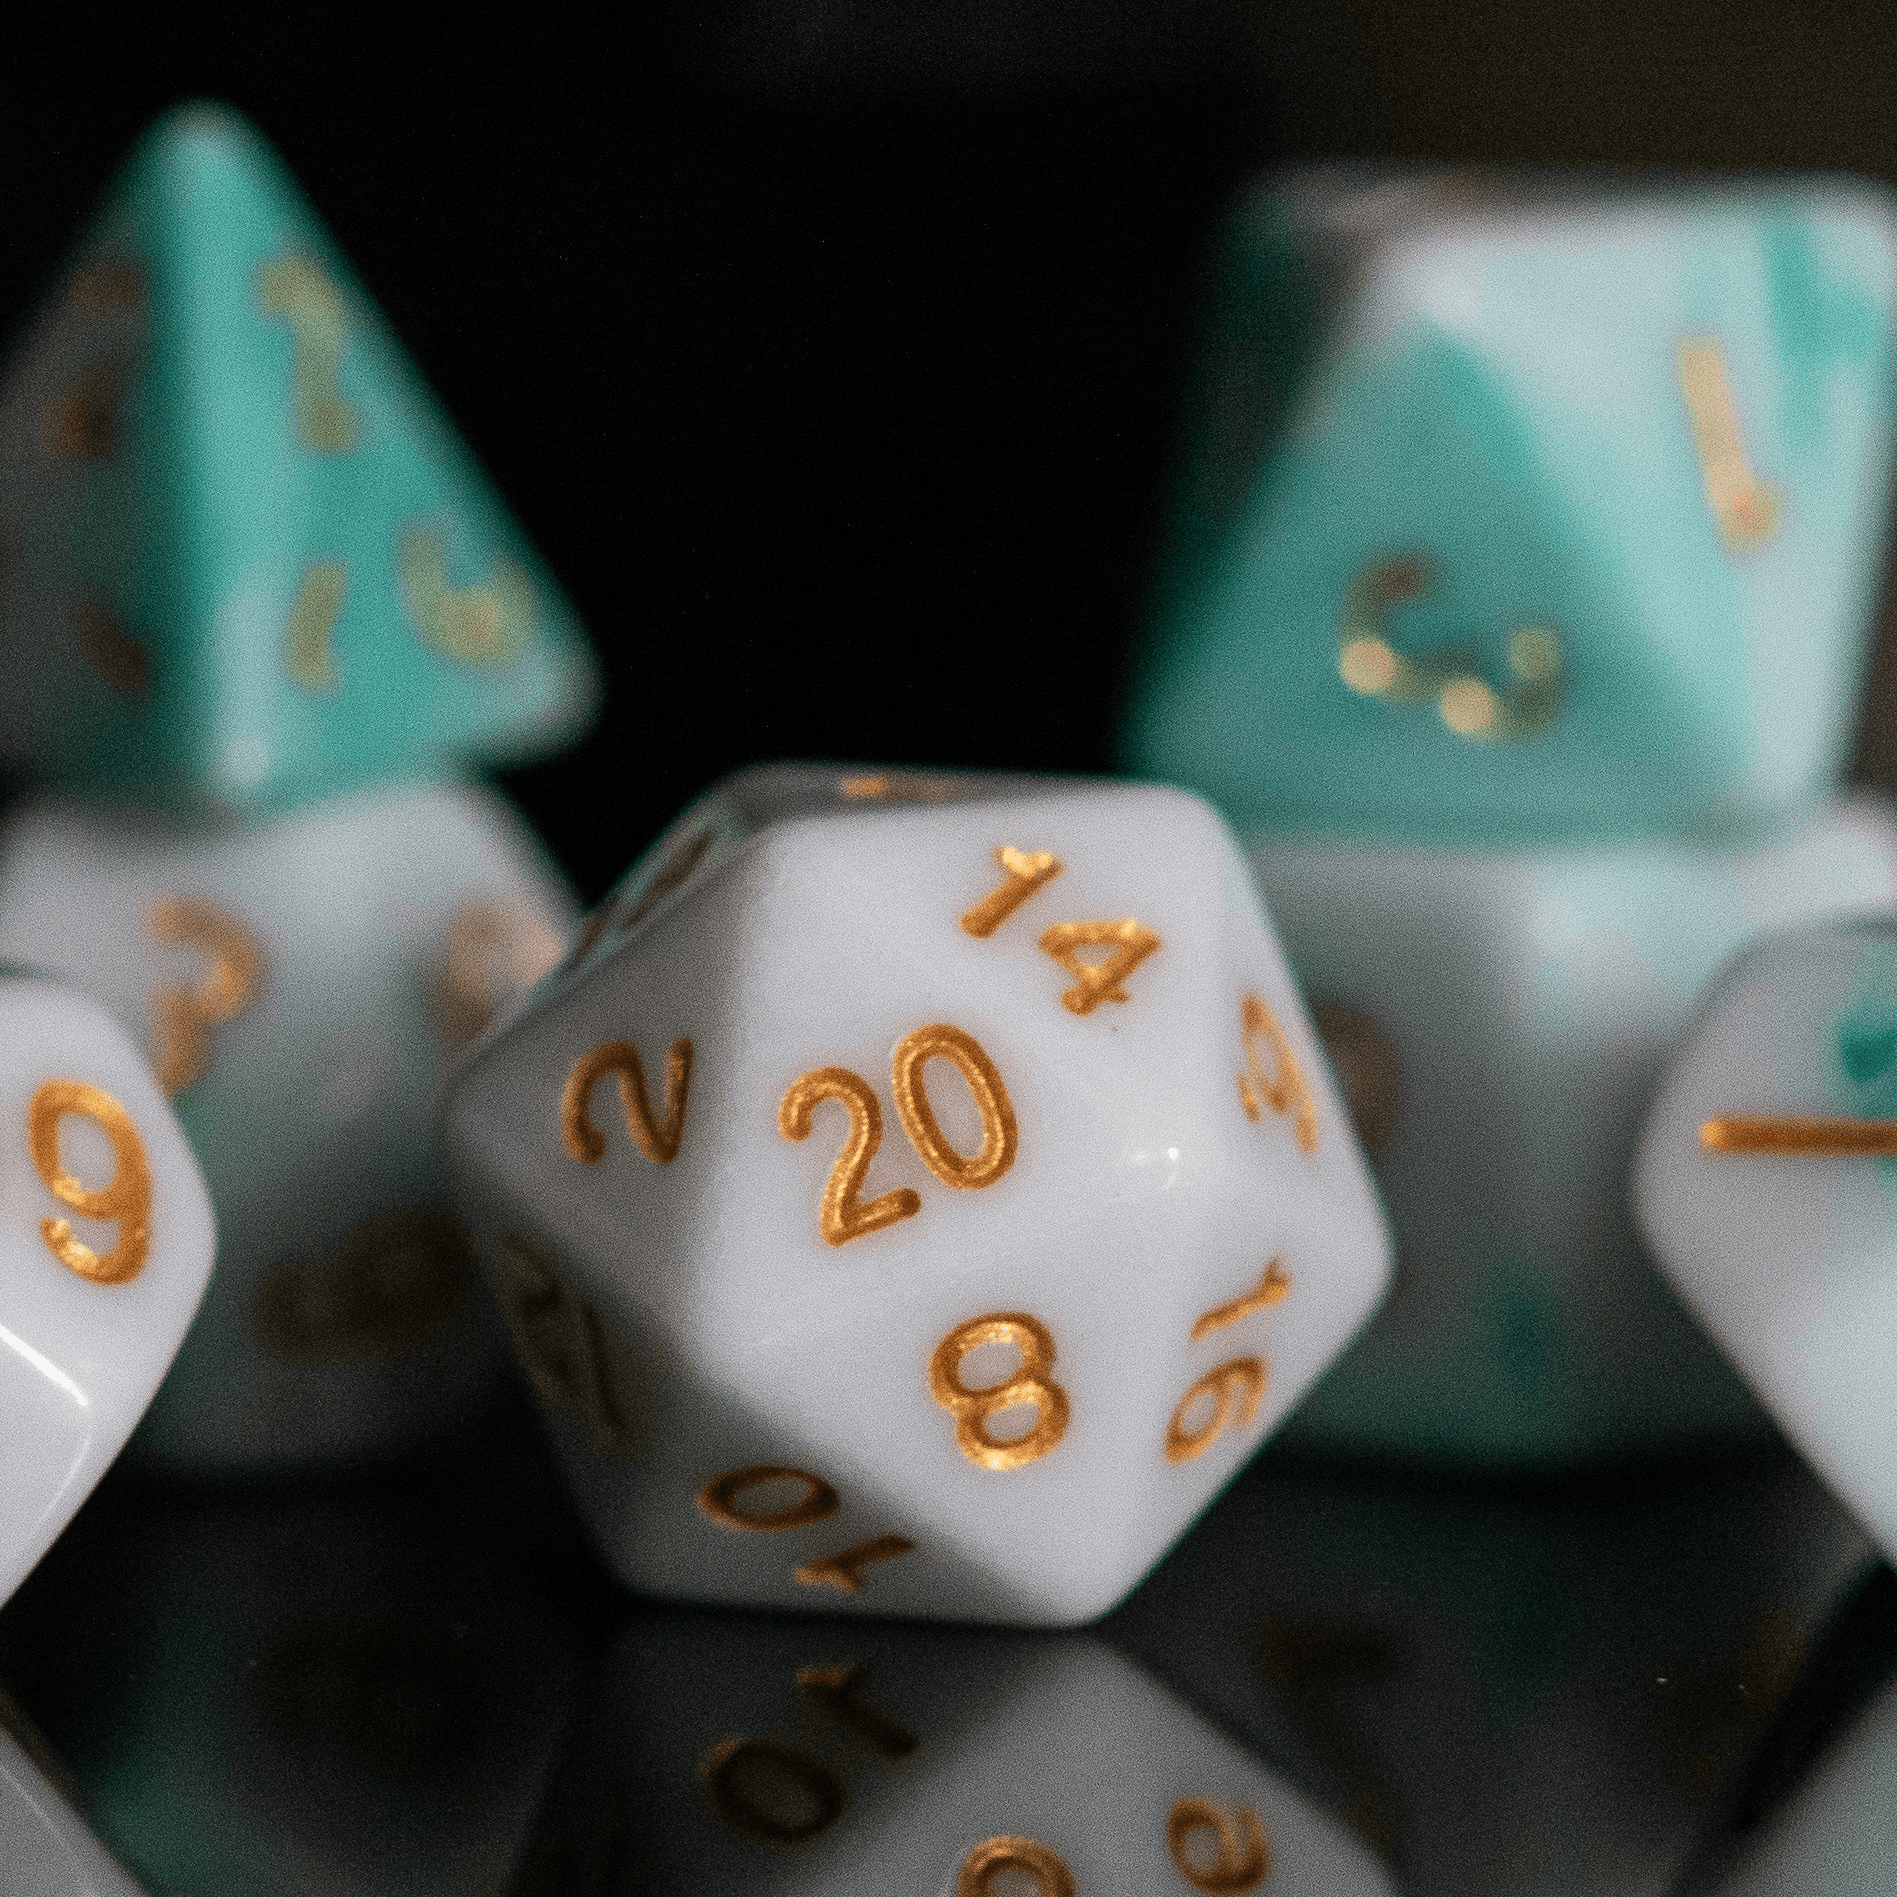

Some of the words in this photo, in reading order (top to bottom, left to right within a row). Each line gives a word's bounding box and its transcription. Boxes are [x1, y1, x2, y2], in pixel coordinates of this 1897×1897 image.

[960, 845, 1161, 1016] 14
[560, 1037, 695, 1165] 2
[777, 1022, 1020, 1248] 20
[927, 1310, 1072, 1471] 8
[1164, 1259, 1292, 1465] 16
[697, 1465, 915, 1593] 10
